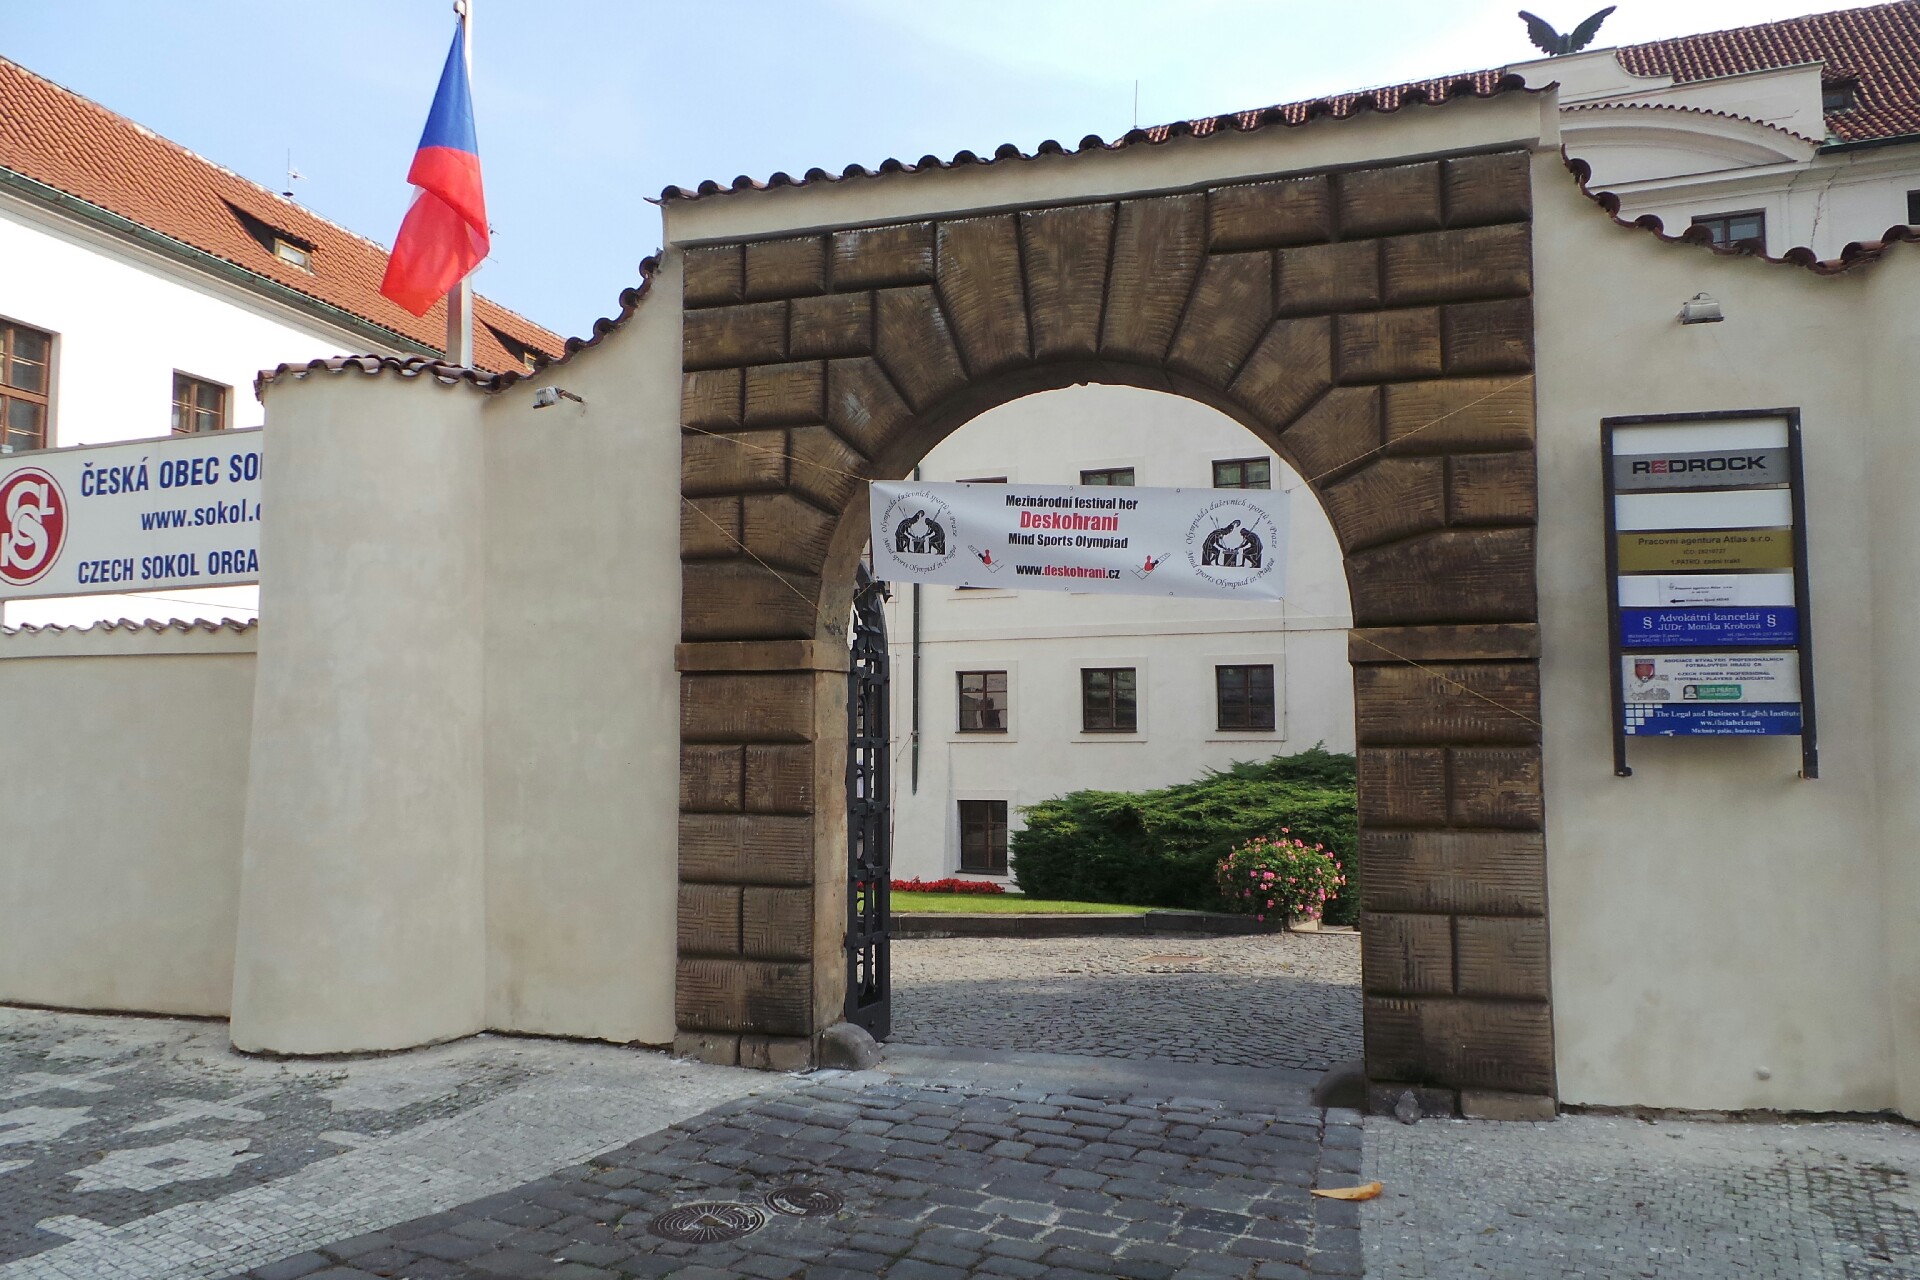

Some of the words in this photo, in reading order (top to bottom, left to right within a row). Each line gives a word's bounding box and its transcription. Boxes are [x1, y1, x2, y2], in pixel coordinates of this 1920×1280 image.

[1632, 456, 1766, 474] REDROCK
[81, 456, 149, 497] ČESKÁ
[159, 456, 220, 489] OBEC
[229, 452, 263, 482] SO
[1005, 494, 1073, 509] Mezinárodní
[1074, 496, 1116, 510] festival
[1119, 497, 1138, 510] her
[1020, 510, 1119, 531] Deskohraní
[1008, 532, 1035, 546] Mind
[1037, 533, 1073, 547] Sports
[1075, 535, 1128, 549] Olympiad
[1681, 536, 1721, 546] agentura
[1723, 535, 1748, 544] Atlas
[77, 558, 134, 584] CZECH
[141, 553, 200, 580] SOKOL
[208, 549, 259, 576] ORGA
[1016, 564, 1120, 579] www.deskohrani.cz
[1658, 612, 1711, 622] Advokátní
[1714, 612, 1760, 621] kancelář
[1658, 623, 1685, 631] JUDr.
[1687, 622, 1721, 631] Monika
[1724, 622, 1761, 630] Krobová
[1655, 710, 1670, 718] The
[1671, 710, 1691, 718] Legal
[1692, 710, 1706, 718] and
